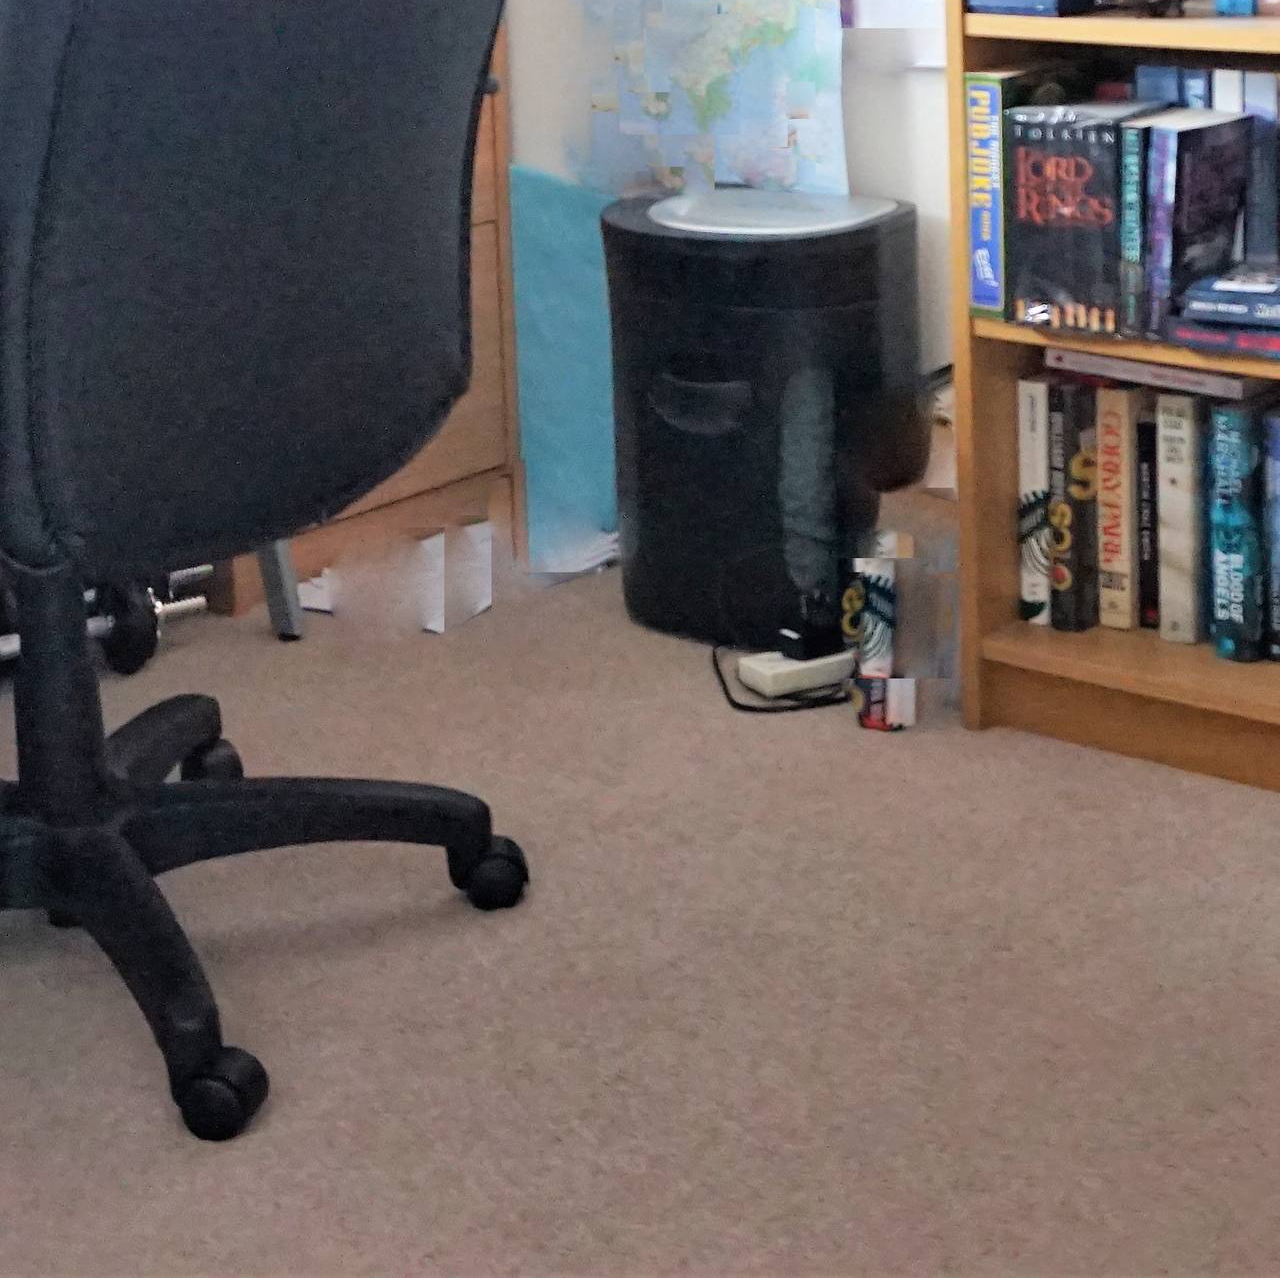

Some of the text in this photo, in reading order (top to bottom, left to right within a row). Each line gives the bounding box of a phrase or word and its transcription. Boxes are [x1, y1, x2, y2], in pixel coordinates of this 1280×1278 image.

[970, 89, 992, 206] PUB JOKE
[1215, 415, 1230, 508] MARSHALL
[1214, 551, 1230, 621] ANGELS
[1230, 554, 1244, 624] BLOOD OF
